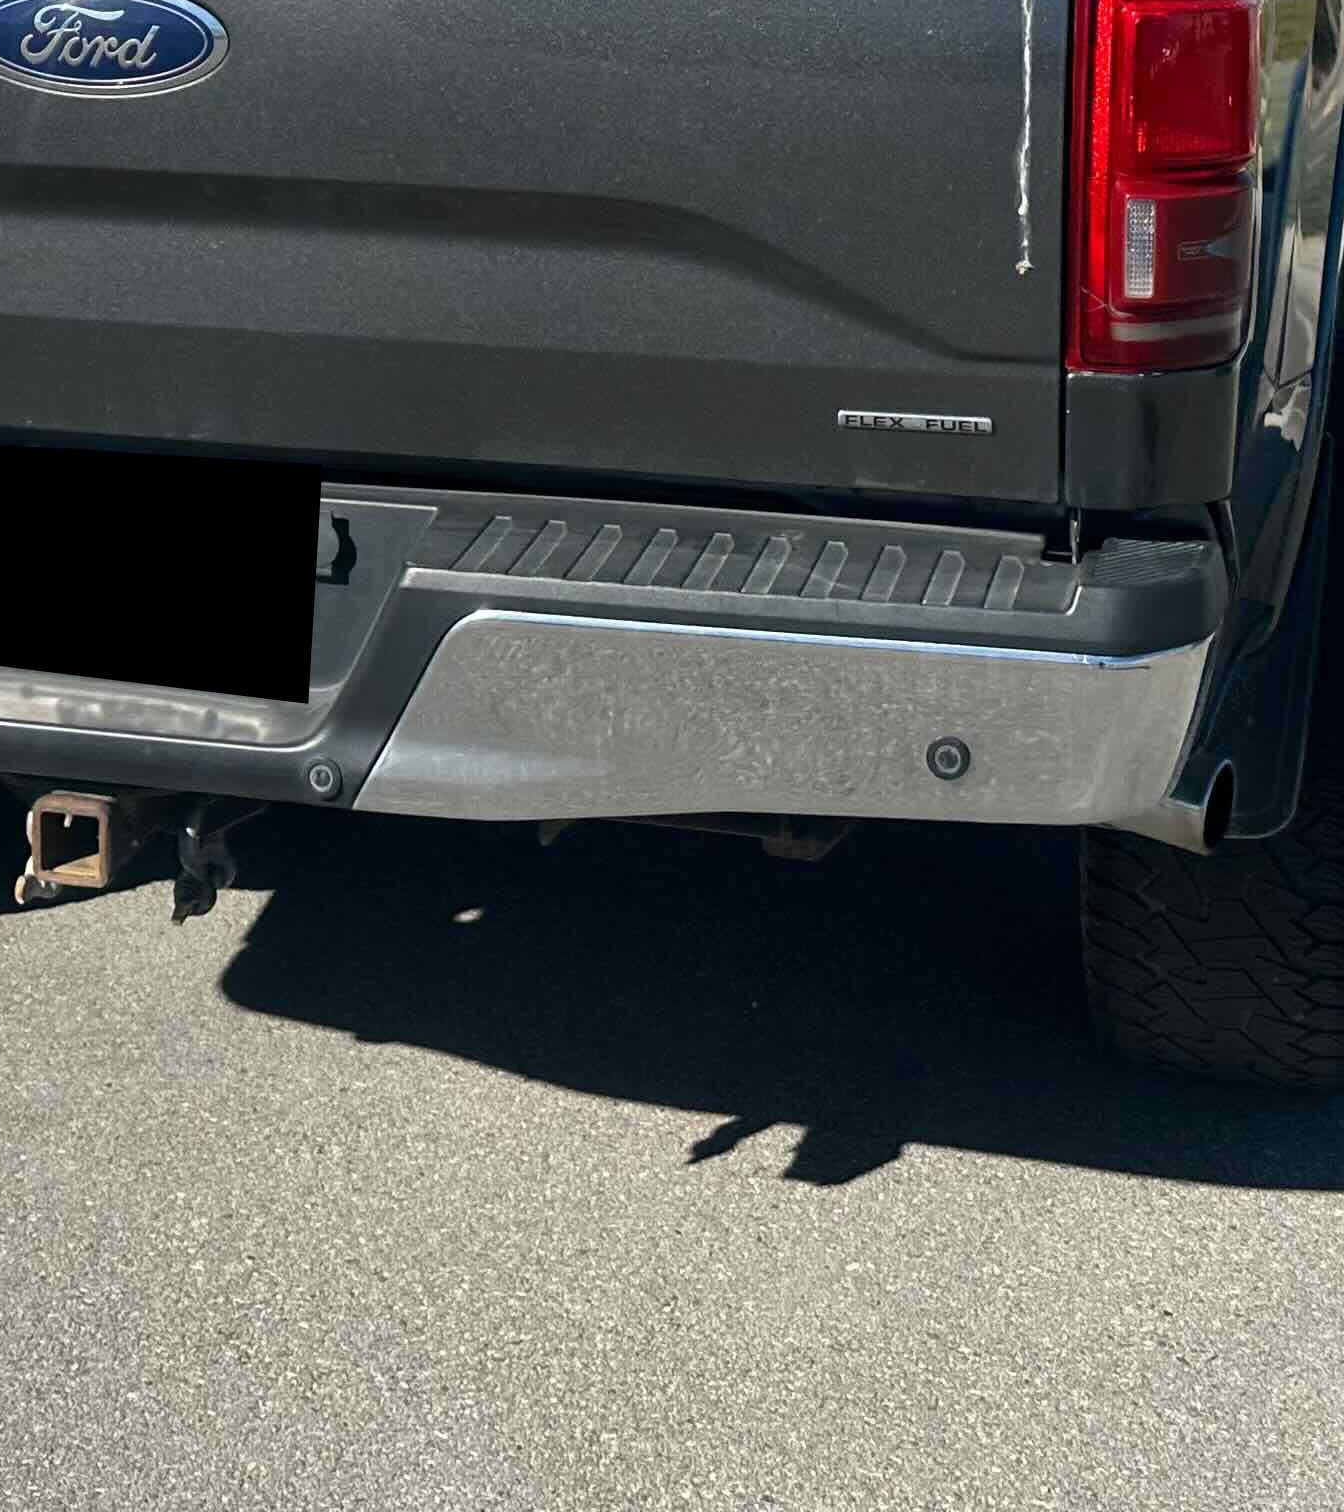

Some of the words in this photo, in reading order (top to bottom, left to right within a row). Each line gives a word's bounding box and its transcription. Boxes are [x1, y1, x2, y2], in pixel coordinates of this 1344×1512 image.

[20, 3, 159, 68] Ford
[845, 415, 905, 429] FLEX
[925, 419, 988, 433] FUEL
